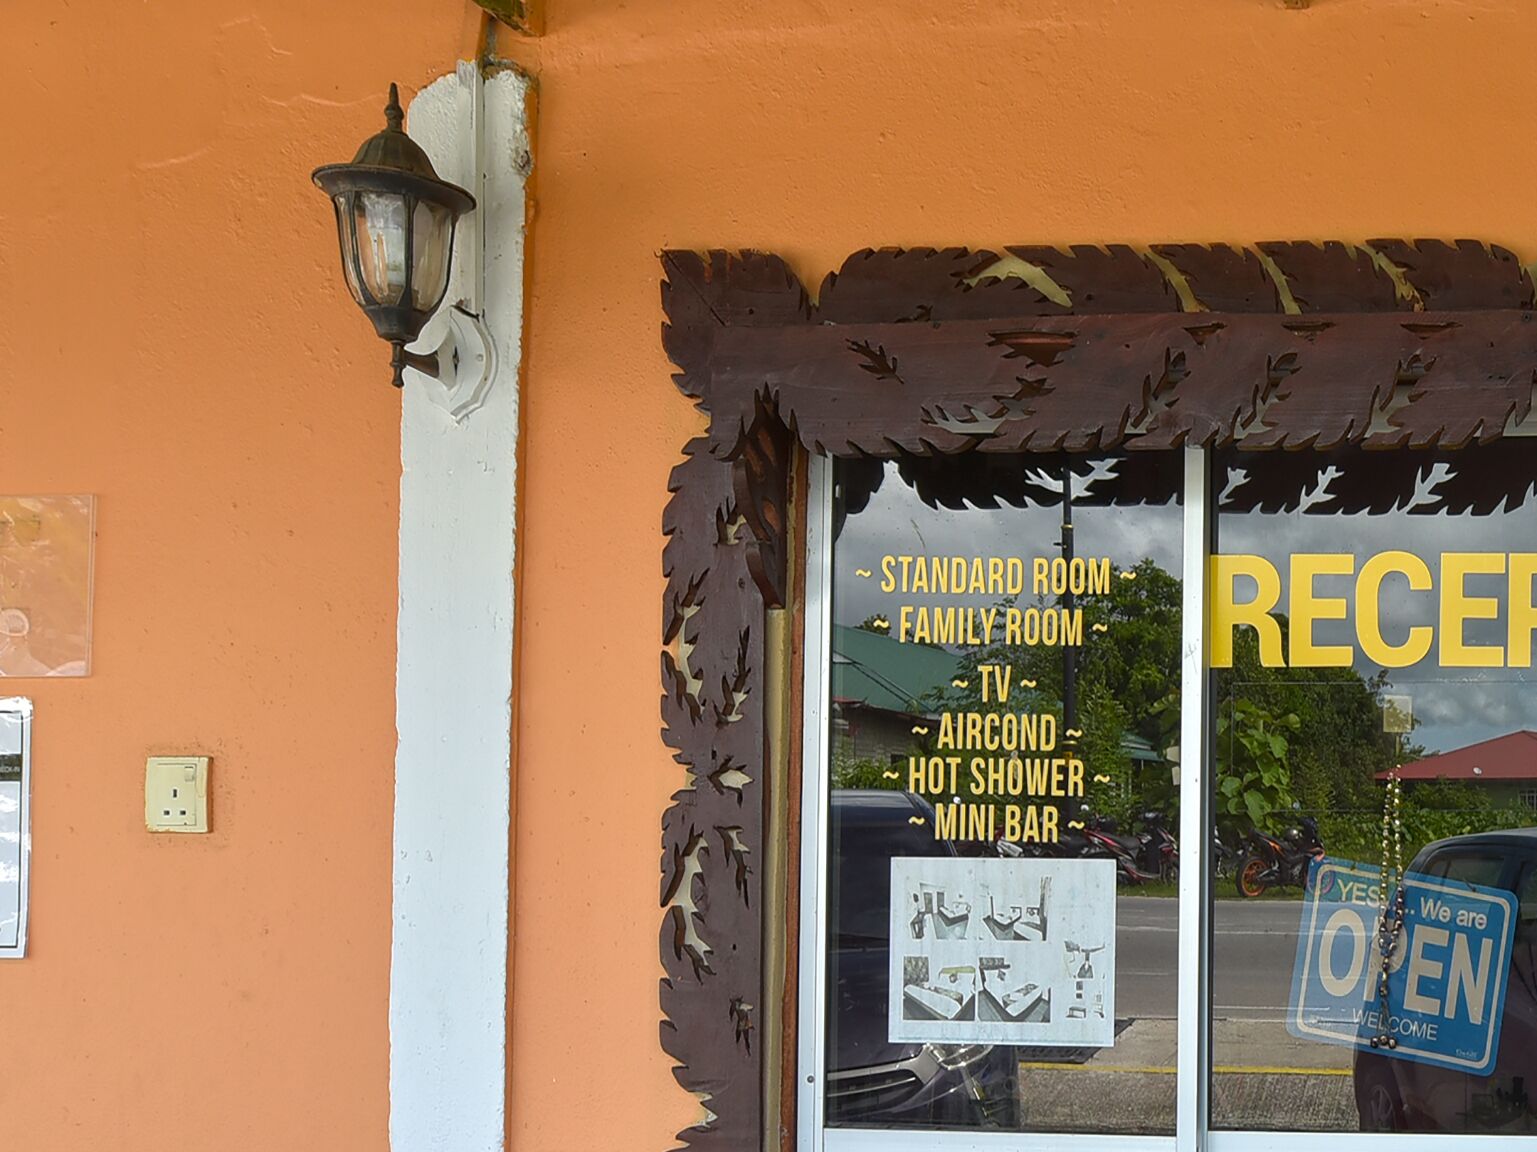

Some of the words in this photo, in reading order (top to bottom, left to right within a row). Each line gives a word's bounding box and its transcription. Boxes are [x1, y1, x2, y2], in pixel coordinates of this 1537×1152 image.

[881, 555, 1024, 596] STANDARD
[1033, 556, 1111, 596] ROOM
[900, 605, 997, 645] FAMILY
[1006, 607, 1083, 647] ROOM
[979, 665, 1012, 703] TV
[938, 712, 1056, 752] AIRCOND
[908, 756, 962, 795] HOT
[970, 755, 1084, 797] SHOWER
[935, 802, 995, 841] MINI
[1005, 804, 1059, 843] BAR
[1420, 896, 1452, 923] We
[1455, 909, 1488, 930] are
[1318, 908, 1493, 1025] OPEN
[1352, 1008, 1439, 1040] WELCOME
